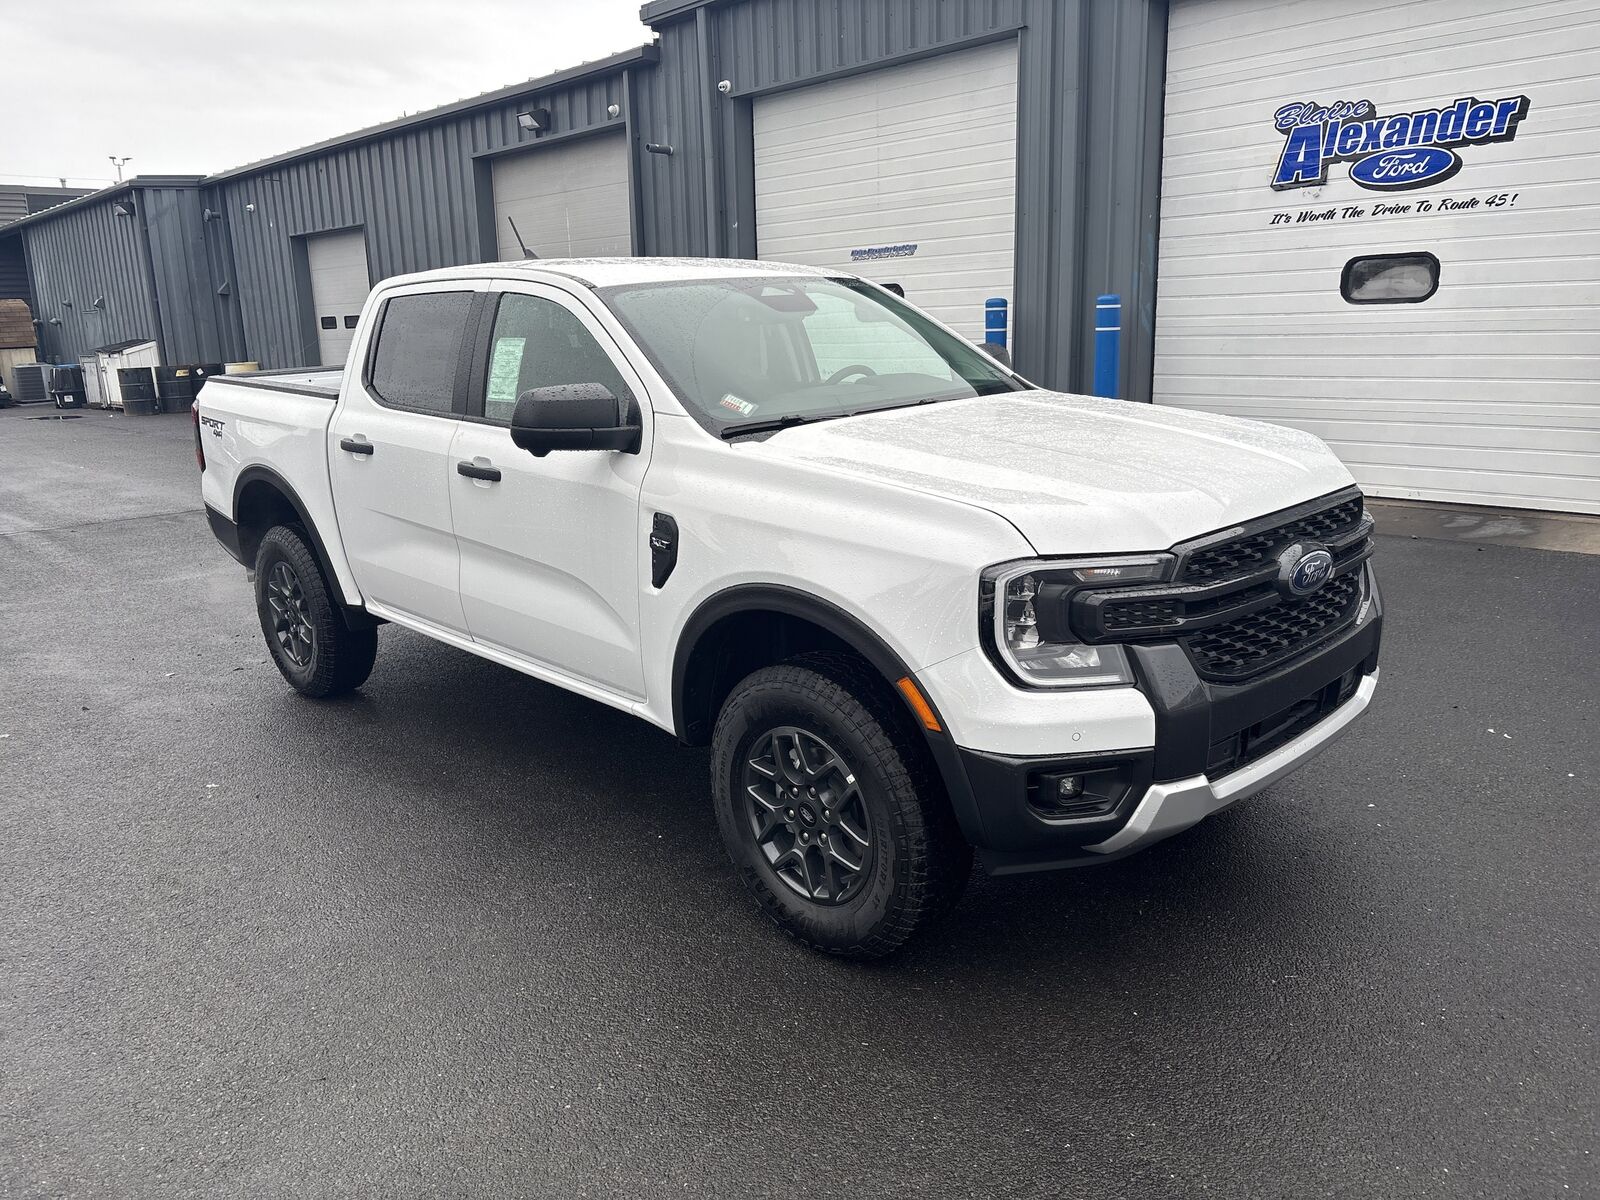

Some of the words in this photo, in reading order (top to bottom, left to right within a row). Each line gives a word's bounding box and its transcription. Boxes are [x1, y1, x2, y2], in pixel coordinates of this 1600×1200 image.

[1275, 100, 1370, 129] Blaise
[1272, 96, 1525, 187] Alexander
[1373, 152, 1429, 179] Ford
[1269, 213, 1292, 226] It's
[1296, 207, 1337, 223] Worth
[1341, 206, 1365, 219] The
[1371, 203, 1412, 217] Drive
[1416, 200, 1433, 213] To
[1437, 197, 1480, 211] Route
[201, 416, 225, 430] SPORT
[1303, 560, 1327, 584] Ford
